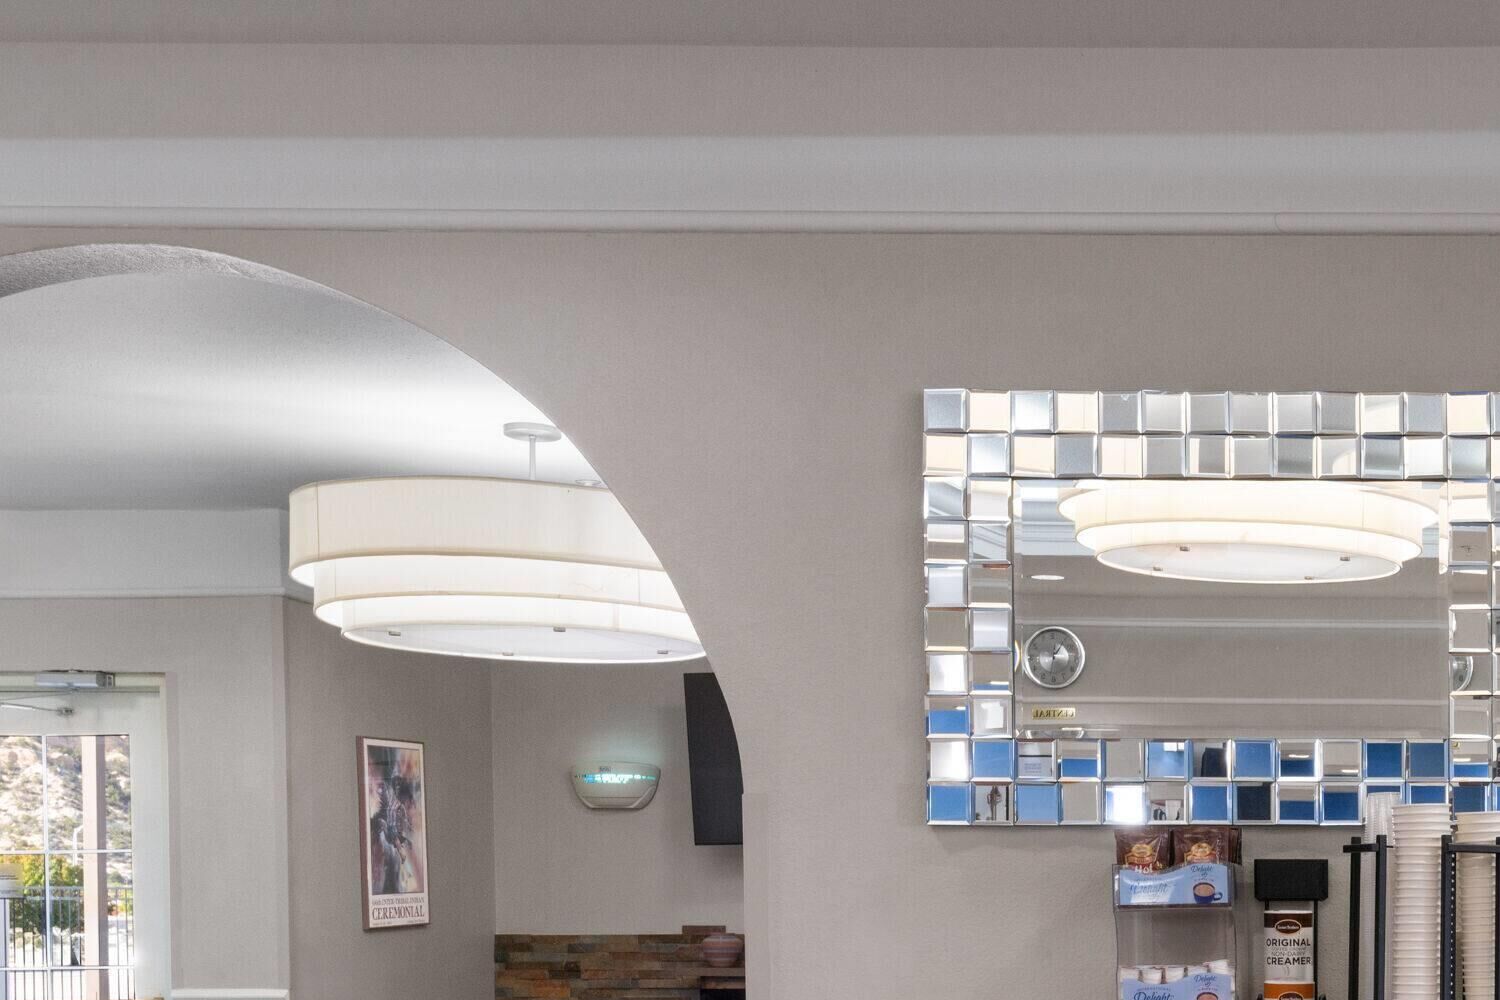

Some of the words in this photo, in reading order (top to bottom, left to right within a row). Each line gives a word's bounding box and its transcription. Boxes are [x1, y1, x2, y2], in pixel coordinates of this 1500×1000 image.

[372, 905, 425, 921] CEREMONIAL
[1266, 938, 1311, 947] ORIGINAL
[1266, 957, 1311, 966] CREAMER
